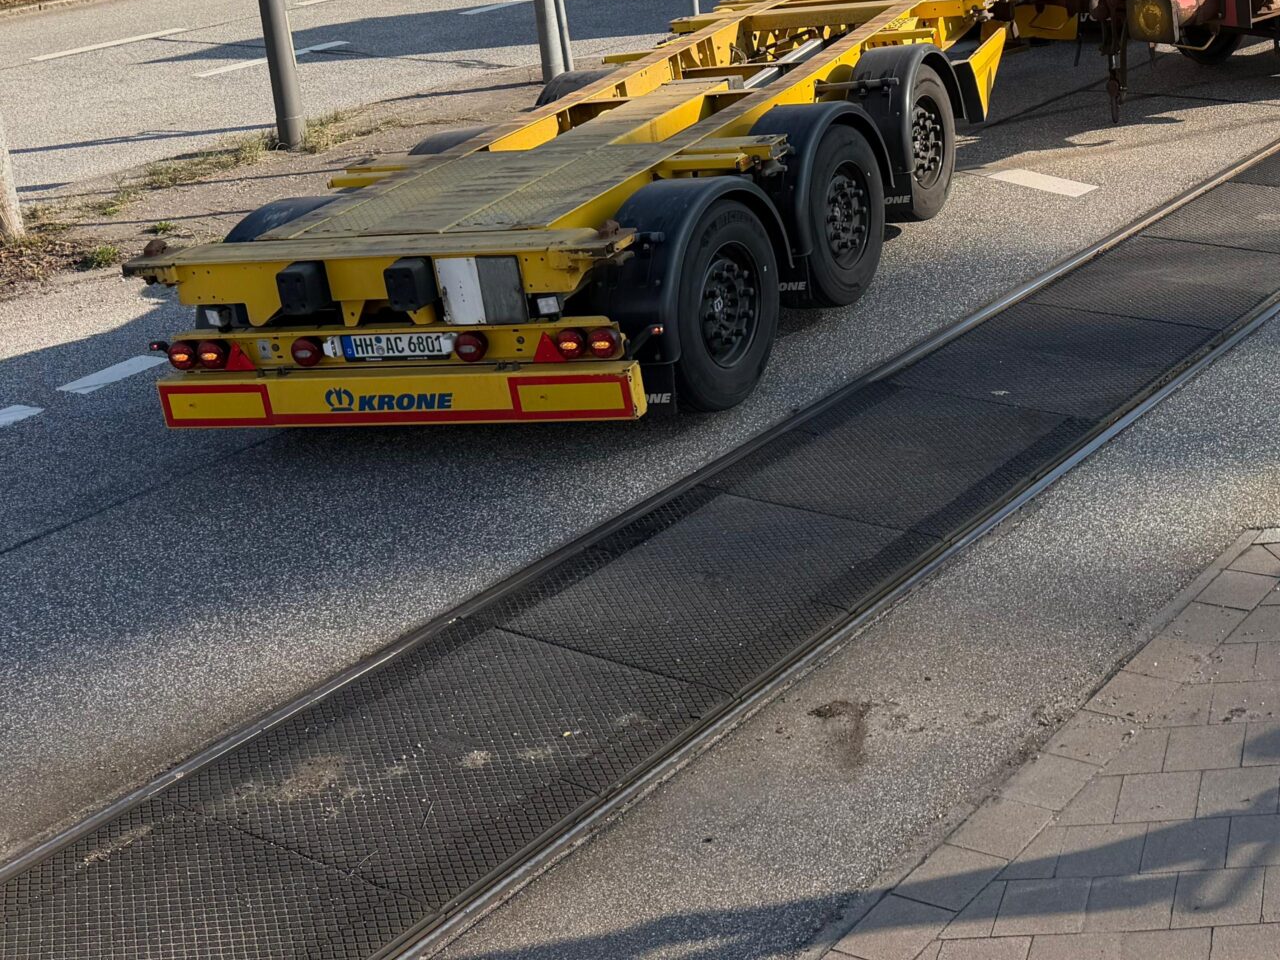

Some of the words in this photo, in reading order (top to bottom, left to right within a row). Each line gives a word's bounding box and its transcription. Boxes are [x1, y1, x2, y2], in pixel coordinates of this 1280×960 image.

[884, 195, 911, 205] ONE
[778, 281, 806, 291] ONE
[353, 337, 375, 356] HH
[385, 336, 405, 355] AC
[408, 335, 443, 353] 6801
[358, 392, 453, 411] KRONE
